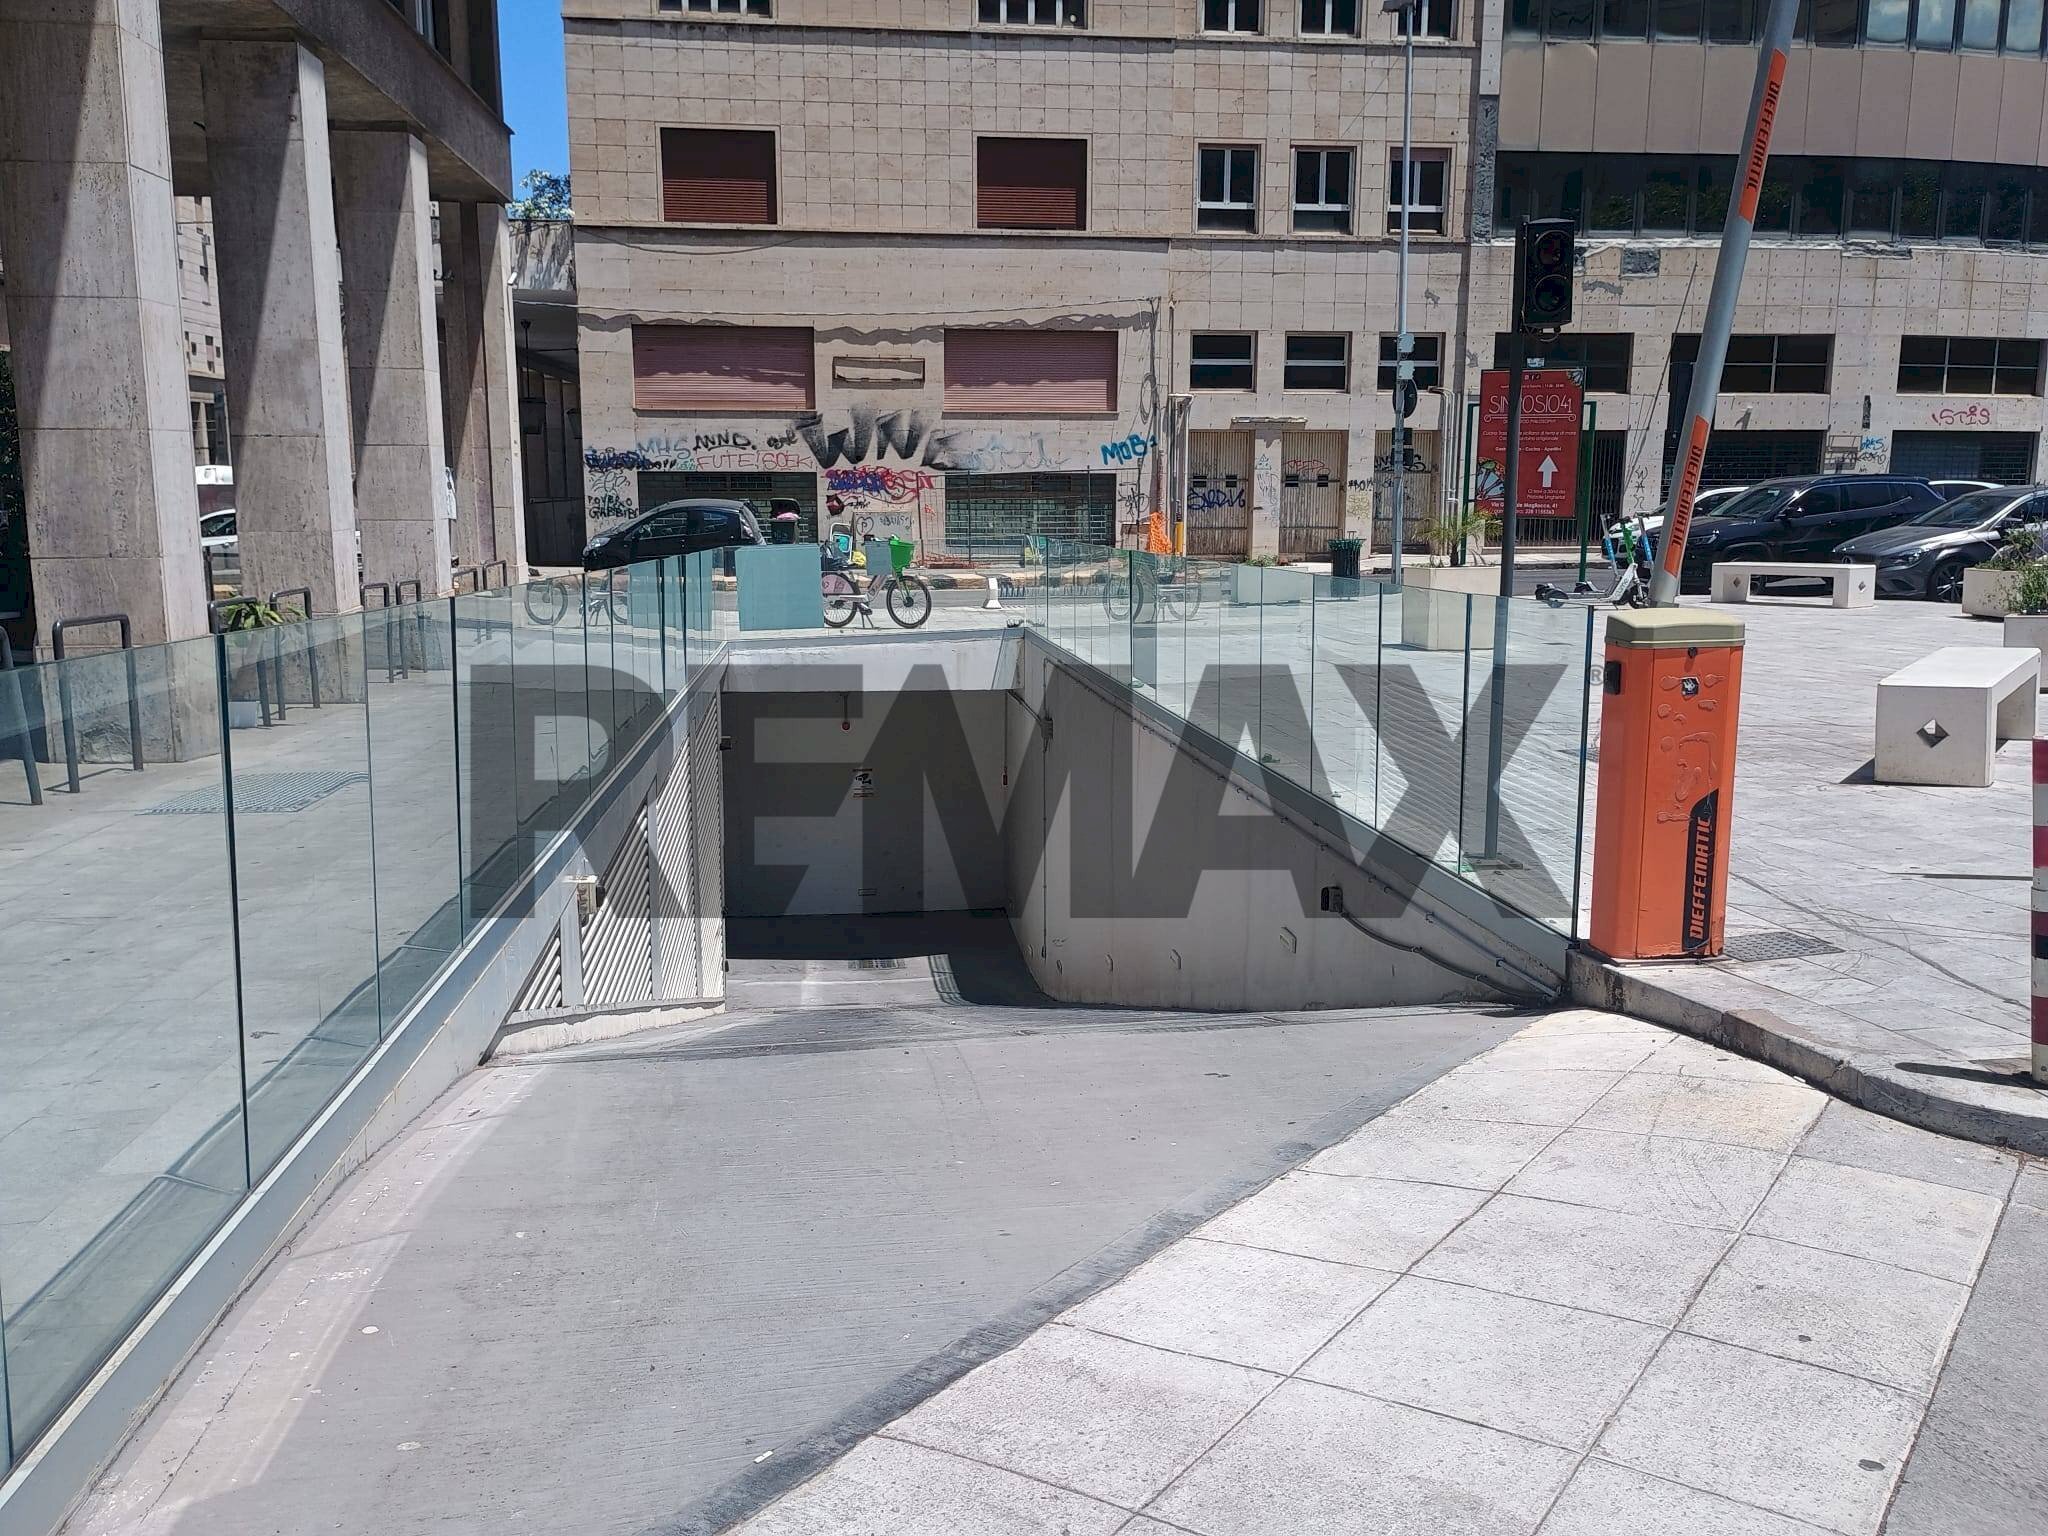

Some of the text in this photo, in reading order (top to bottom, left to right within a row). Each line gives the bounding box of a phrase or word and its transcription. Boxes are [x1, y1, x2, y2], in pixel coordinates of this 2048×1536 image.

[1746, 80, 1780, 190] DIEFFEMATIC
[1489, 394, 1572, 414] SIOSIO41
[1671, 445, 1703, 547] DIEFFEMATIC
[1689, 816, 1713, 940] DIEFFEMATIC
